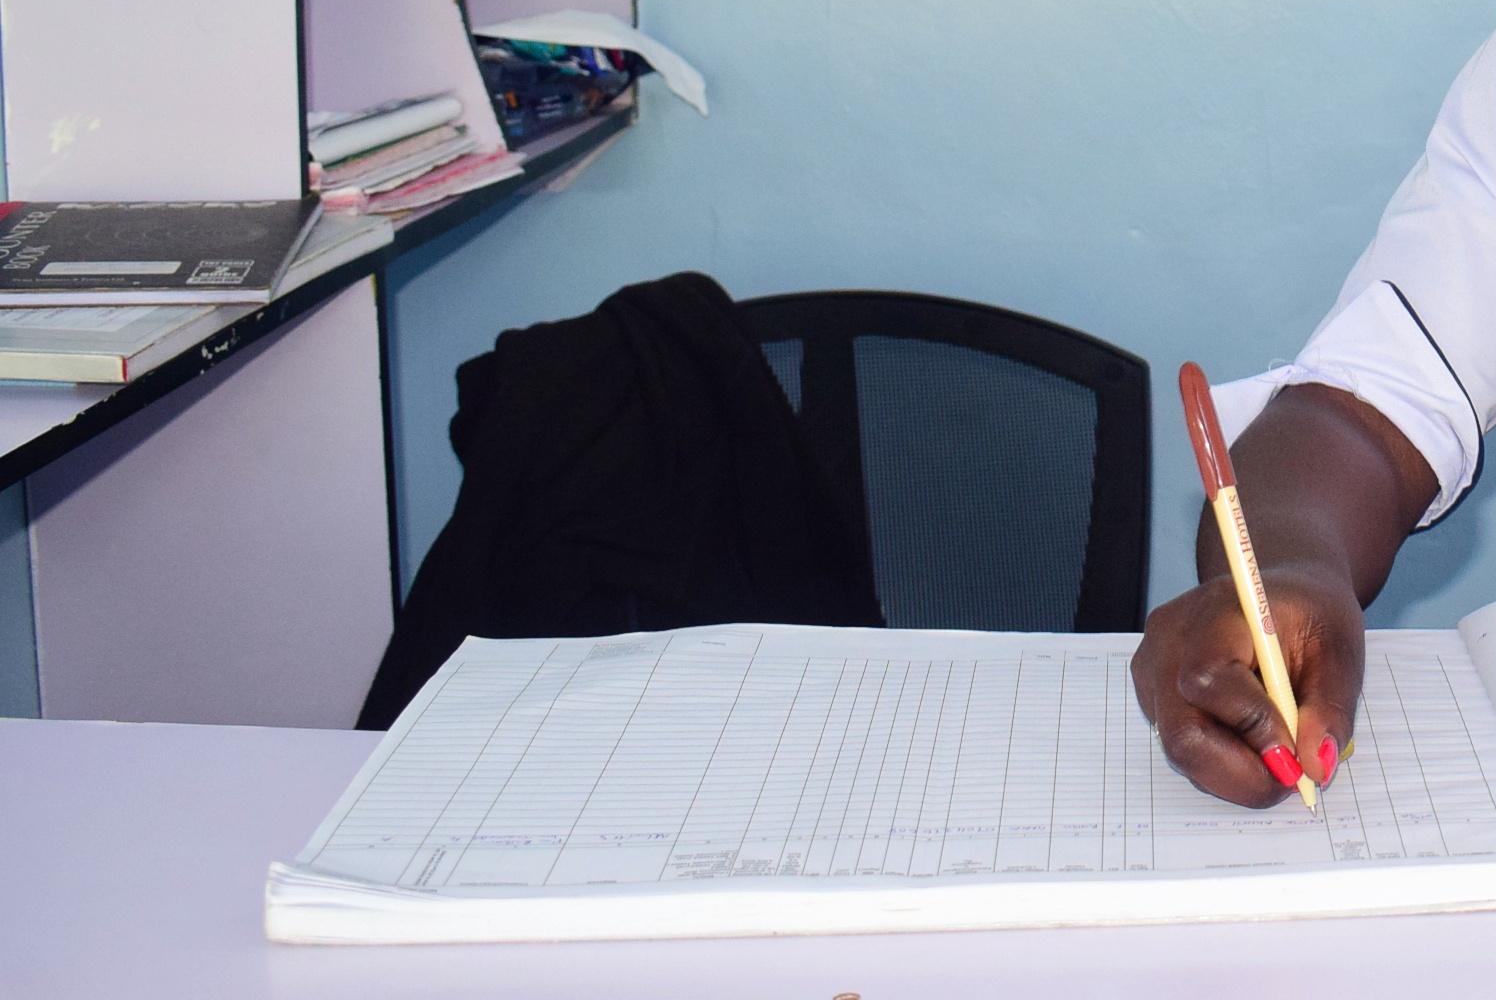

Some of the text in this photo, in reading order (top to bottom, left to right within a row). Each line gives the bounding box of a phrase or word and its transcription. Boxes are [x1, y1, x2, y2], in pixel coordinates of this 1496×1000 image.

[3, 244, 50, 270] BOOK
[1228, 494, 1271, 615] SERENA HOTELS
